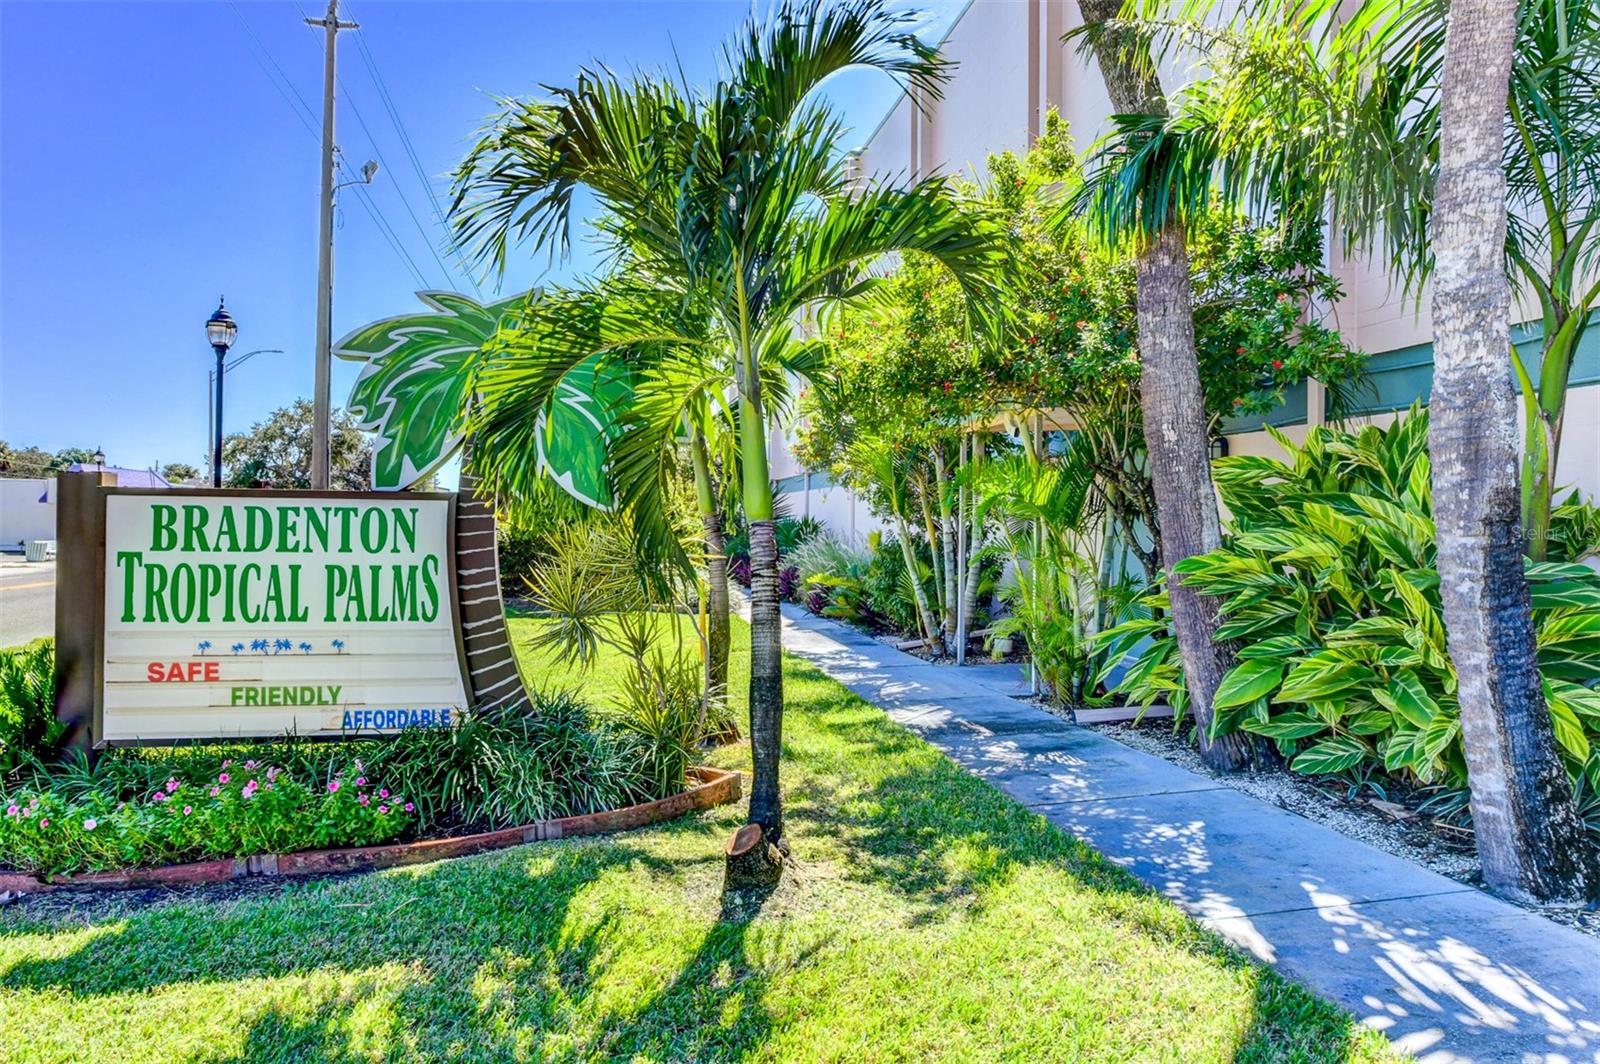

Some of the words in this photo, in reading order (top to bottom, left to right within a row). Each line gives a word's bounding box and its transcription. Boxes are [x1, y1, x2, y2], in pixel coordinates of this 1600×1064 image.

[150, 504, 418, 554] BRADENTON
[117, 551, 309, 624] TROPICAL
[324, 553, 439, 624] PALMS
[147, 661, 220, 683] SAFE
[231, 685, 342, 706] FRIENDLY
[342, 708, 451, 730] AFFORDABLE
